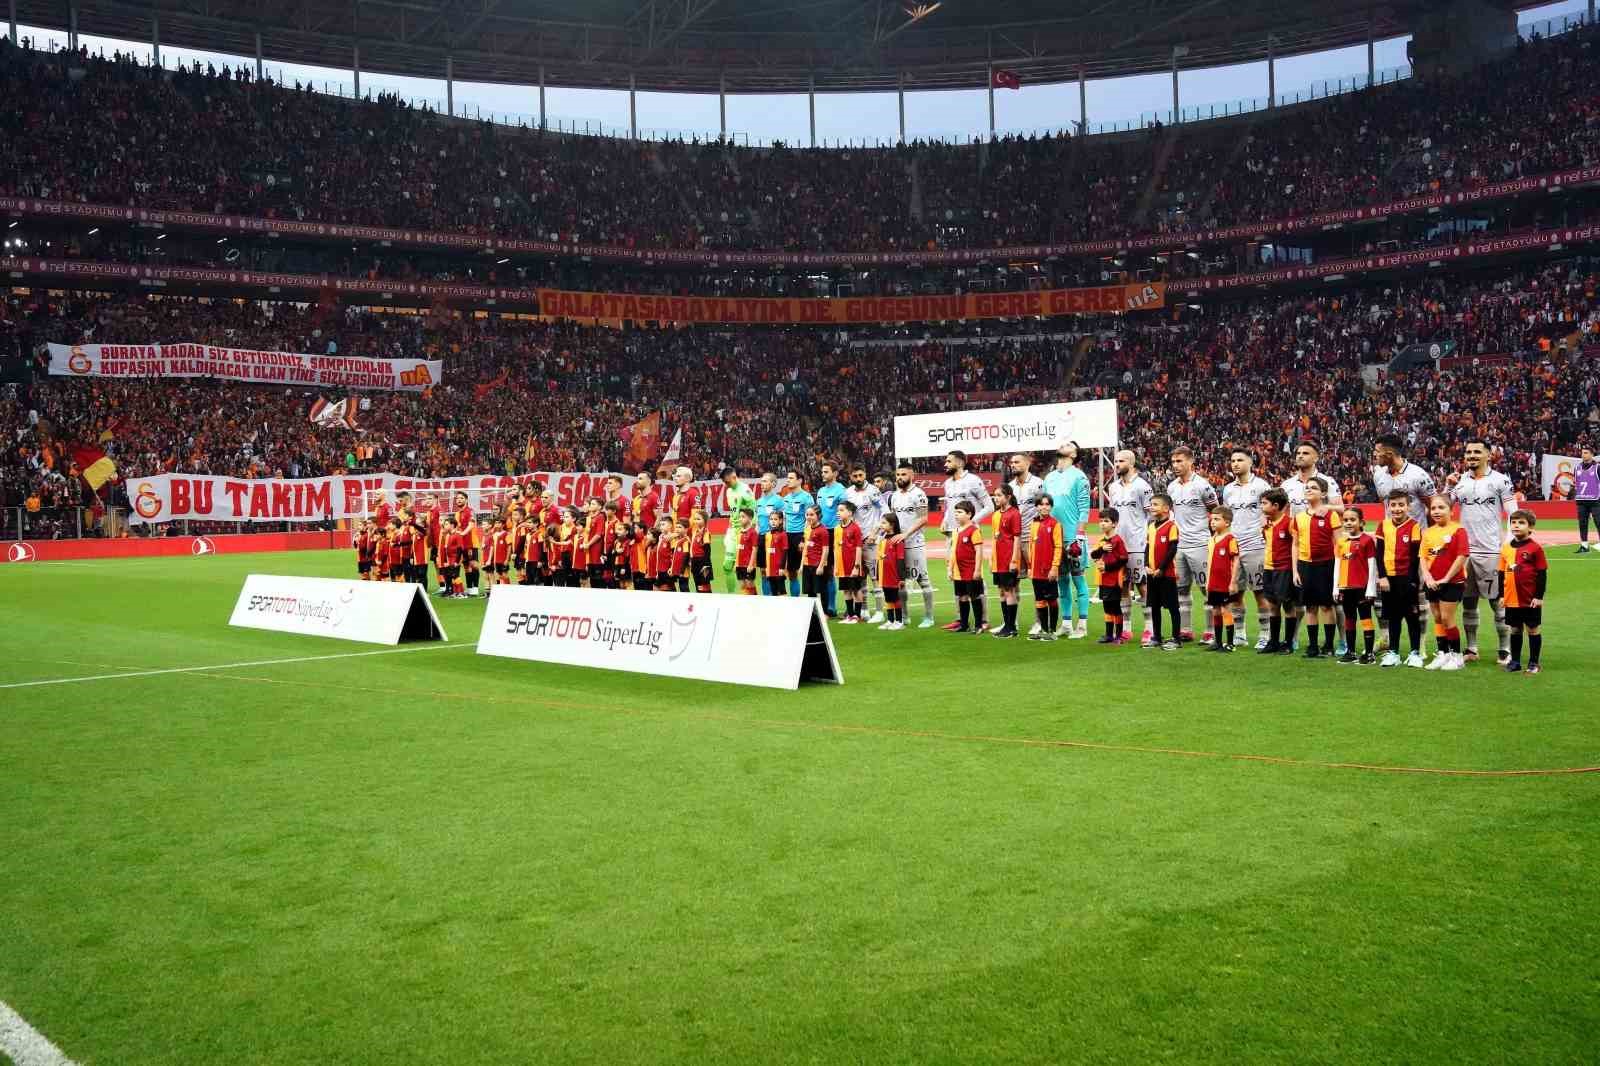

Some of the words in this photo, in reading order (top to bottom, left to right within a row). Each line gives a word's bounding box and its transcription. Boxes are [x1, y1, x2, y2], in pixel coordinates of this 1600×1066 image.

[101, 346, 156, 359] BURAYA
[160, 345, 204, 359] KADAR
[170, 360, 250, 378] KALDIRACAK
[254, 365, 286, 380] OLAN
[1001, 421, 1056, 442] SüperLig
[1579, 481, 1588, 495] 7
[170, 479, 213, 516] BU
[225, 481, 332, 518] TAKIM
[1484, 580, 1494, 595] 7
[506, 612, 592, 640] SPORTOTO
[592, 616, 663, 655] SüperLig
